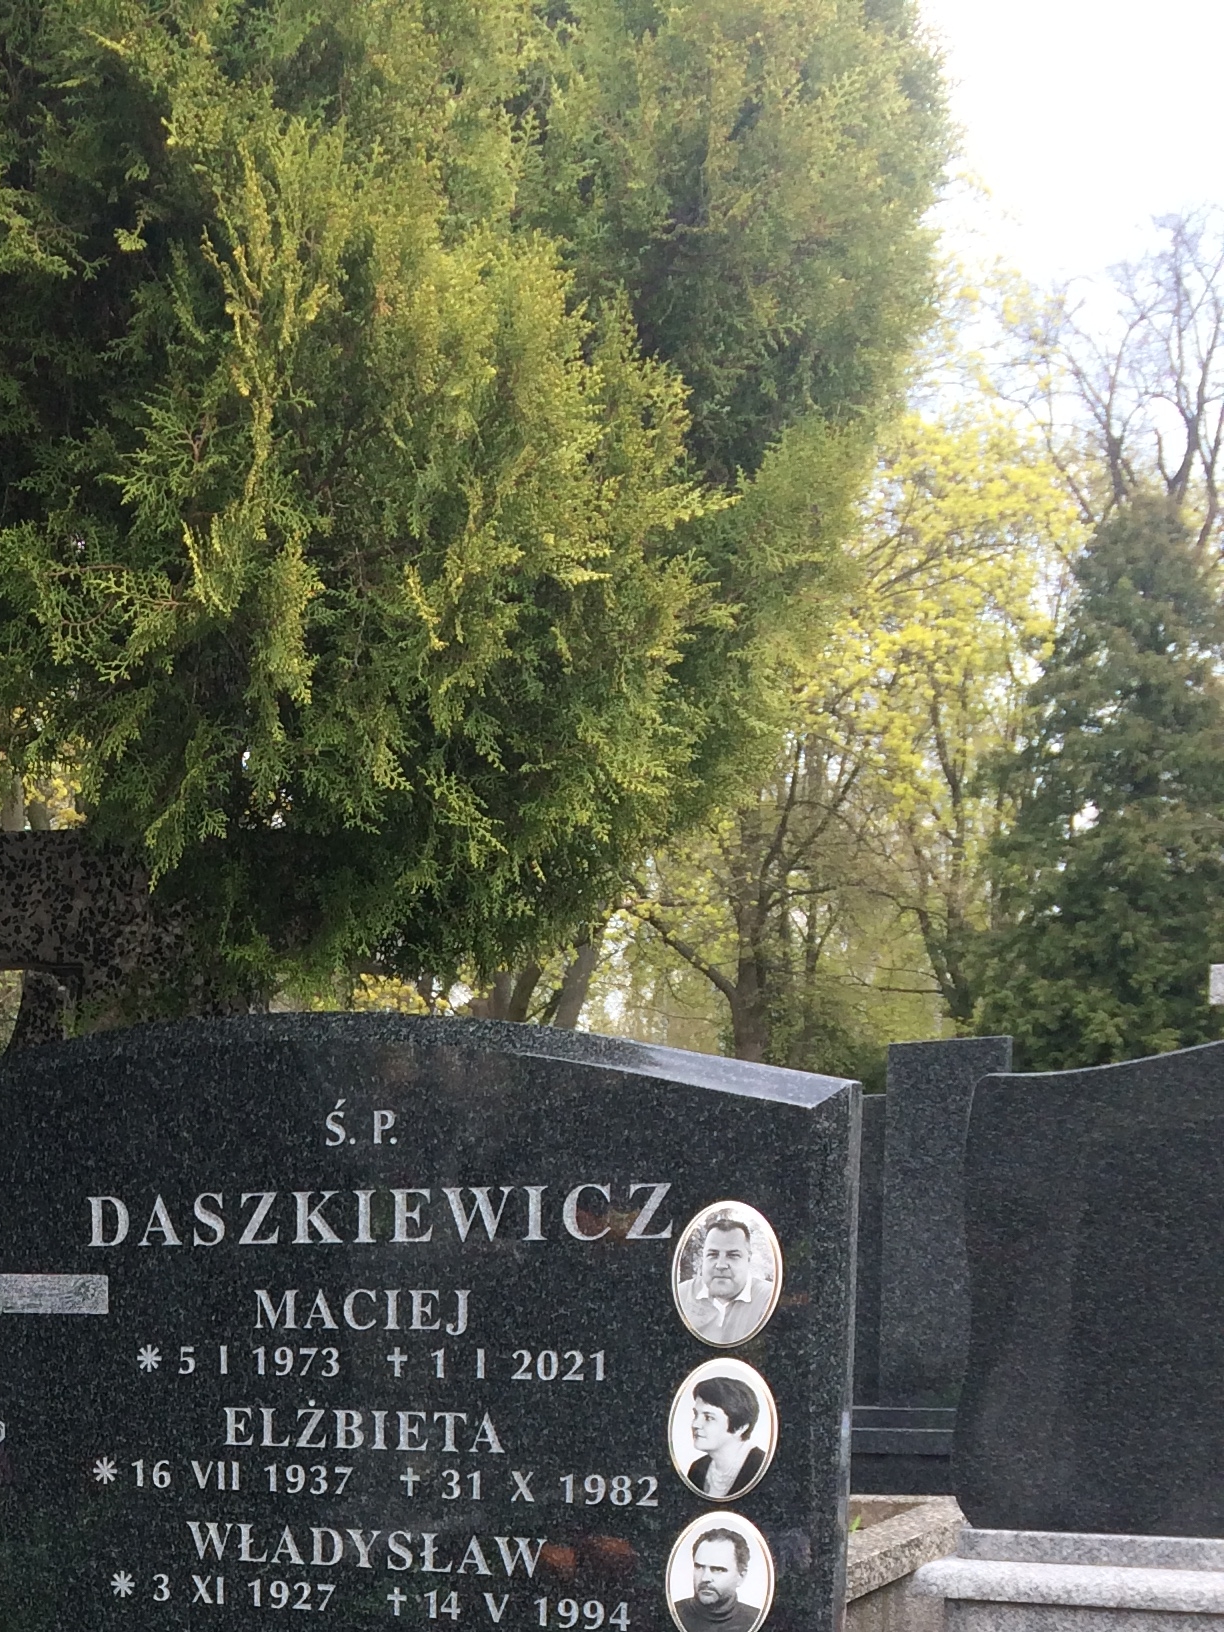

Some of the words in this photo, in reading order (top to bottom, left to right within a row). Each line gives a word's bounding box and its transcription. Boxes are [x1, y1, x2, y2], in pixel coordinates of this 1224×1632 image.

[324, 1100, 356, 1148] Ś.
[372, 1108, 399, 1147] P.
[85, 1181, 675, 1248] DASZKIEWICZ
[253, 1288, 472, 1336] MACIEJ
[177, 1346, 197, 1376] 5
[251, 1345, 341, 1378] 1973
[430, 1348, 446, 1379] 1
[510, 1348, 607, 1382] 2021
[223, 1400, 506, 1454] ELŻBIETA
[130, 1458, 171, 1490] 16
[190, 1460, 241, 1492] VII
[262, 1462, 354, 1496] 1937
[441, 1468, 481, 1500] 31
[510, 1470, 536, 1503] X
[559, 1472, 659, 1507] 1982
[185, 1519, 548, 1580] WŁADYSŁAW
[152, 1573, 171, 1602] 3
[191, 1573, 225, 1605] XI
[247, 1577, 337, 1613] 1927
[423, 1588, 462, 1621] 14
[482, 1591, 510, 1624] V
[533, 1594, 631, 1632] 1994
